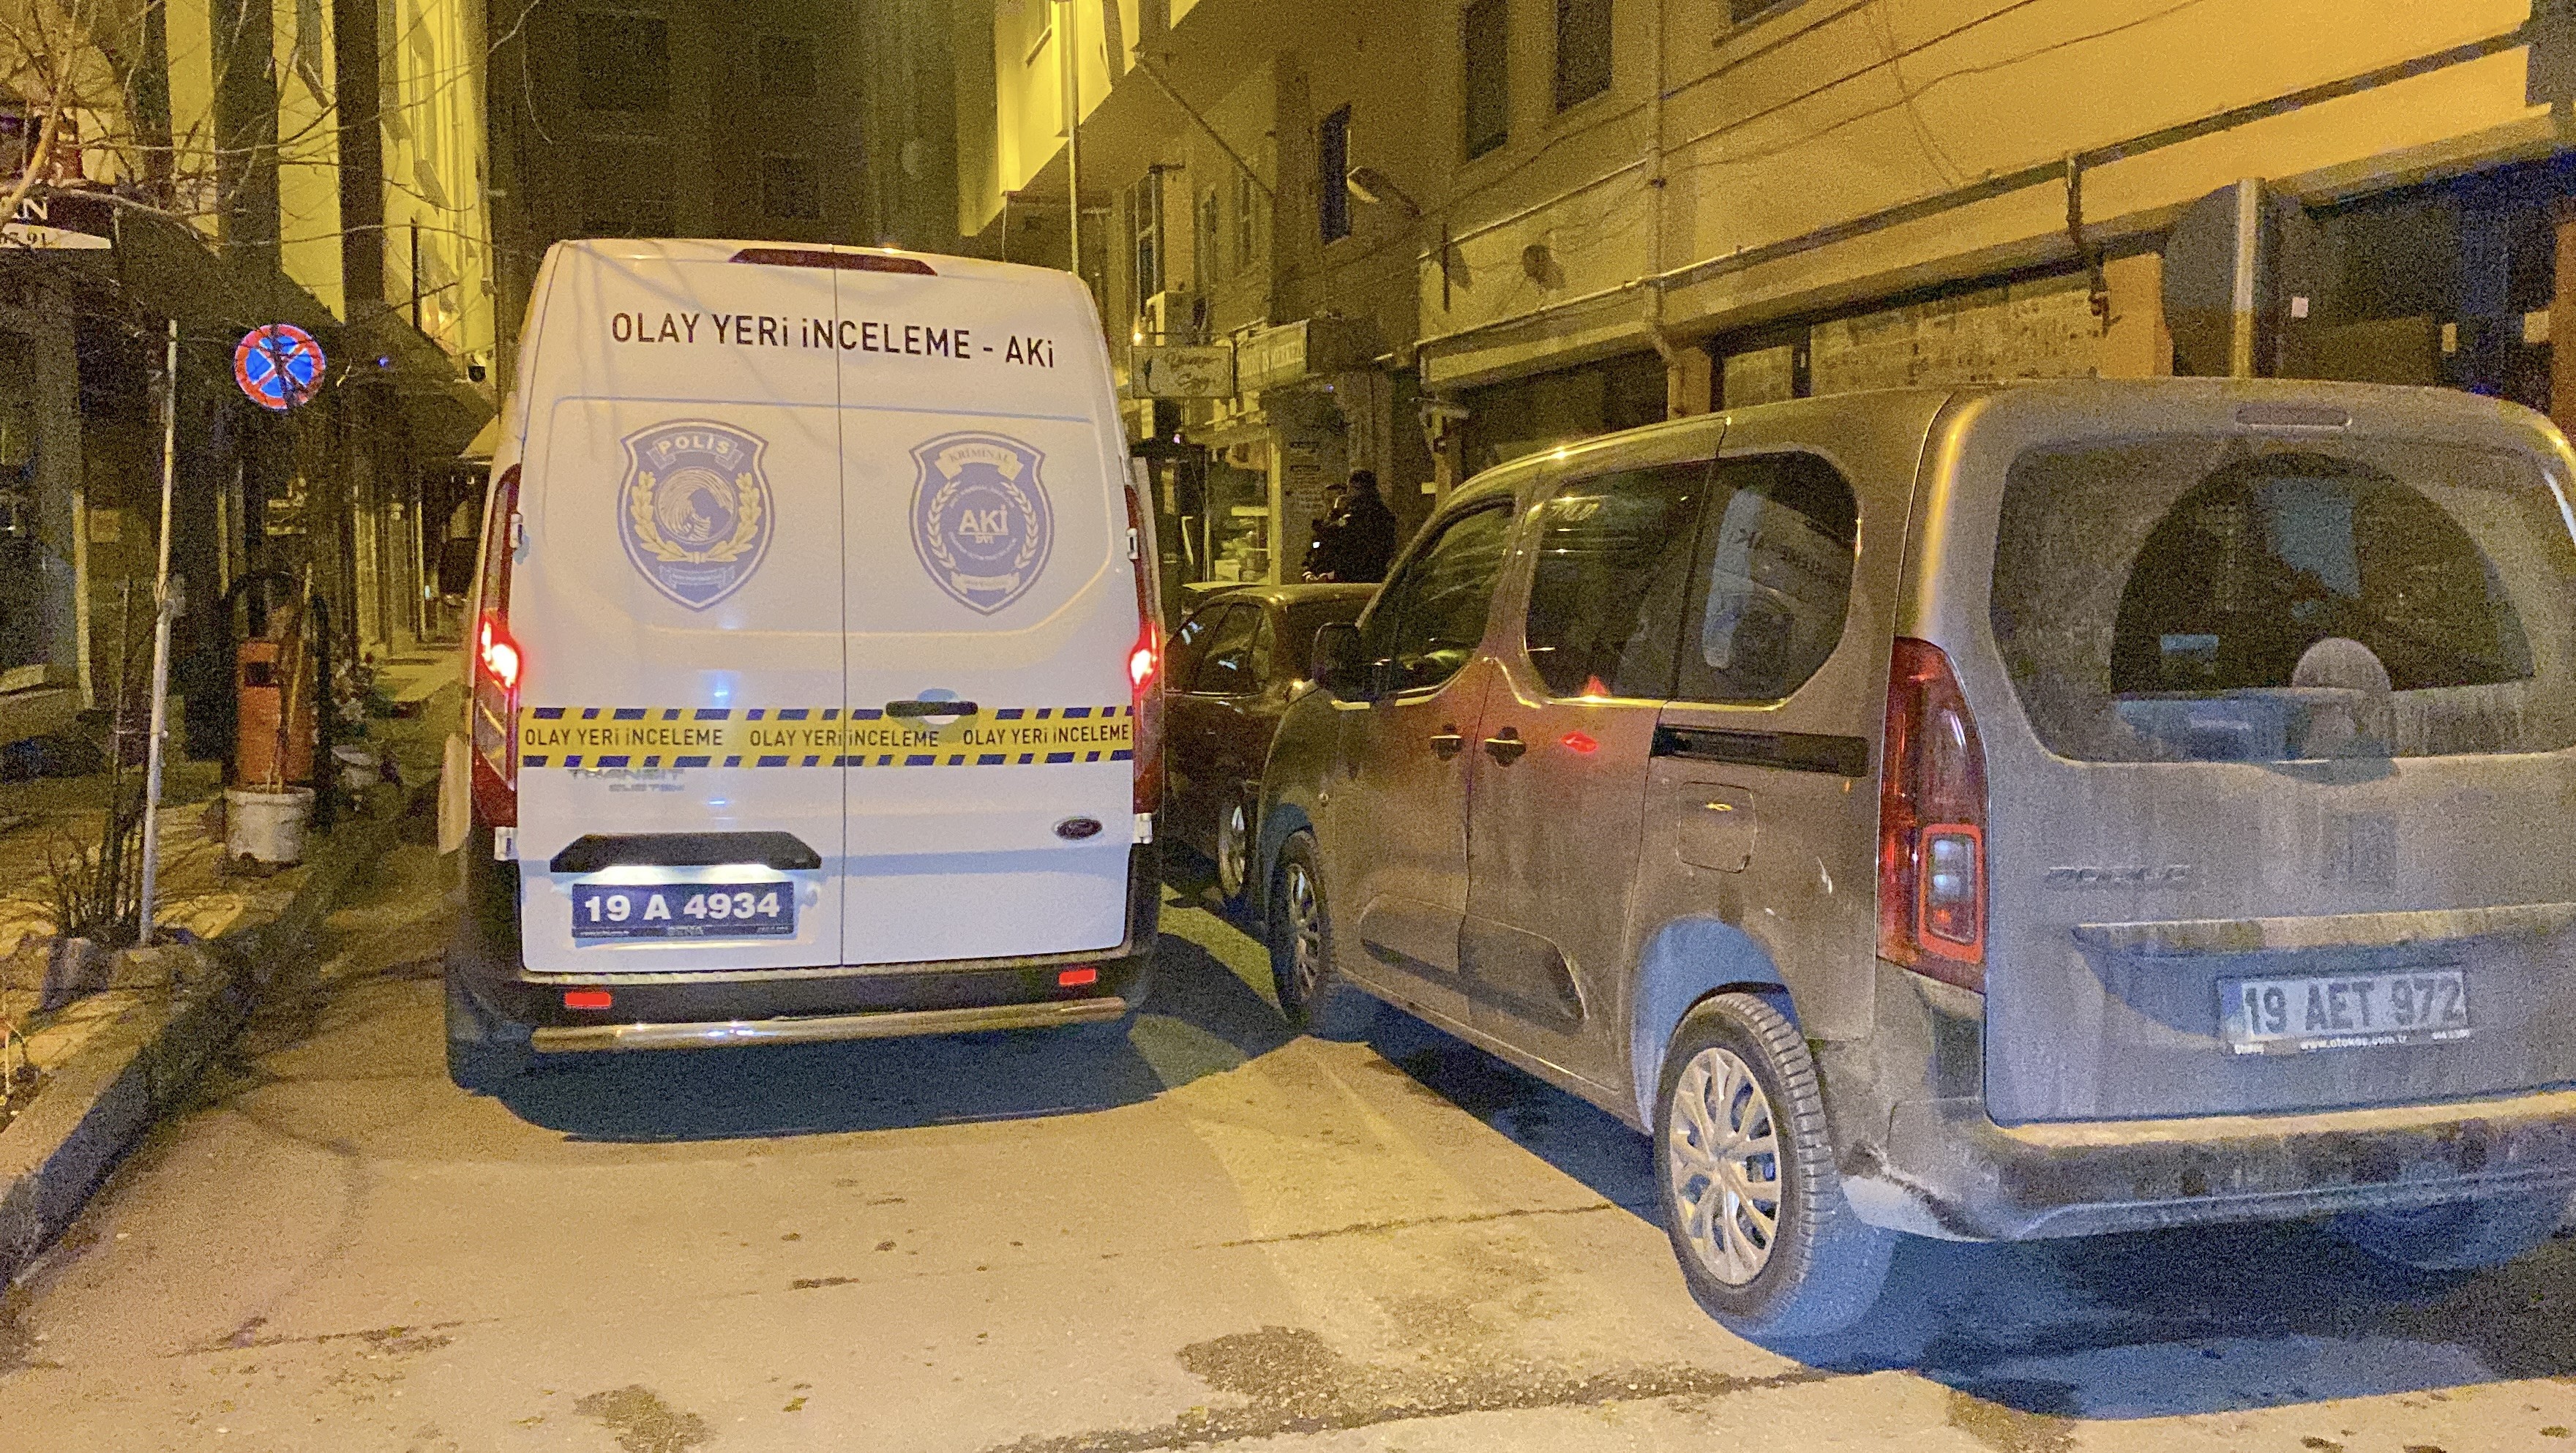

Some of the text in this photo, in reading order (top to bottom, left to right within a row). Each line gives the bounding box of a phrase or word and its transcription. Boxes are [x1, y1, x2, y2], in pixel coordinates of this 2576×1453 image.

[612, 312, 700, 343] OLAY
[525, 728, 570, 746] OLAY
[749, 729, 795, 747] OLAY
[963, 729, 1006, 745] OLAY
[585, 892, 780, 922] 19 A 4934
[2244, 978, 2465, 1034] 19 AET 972
